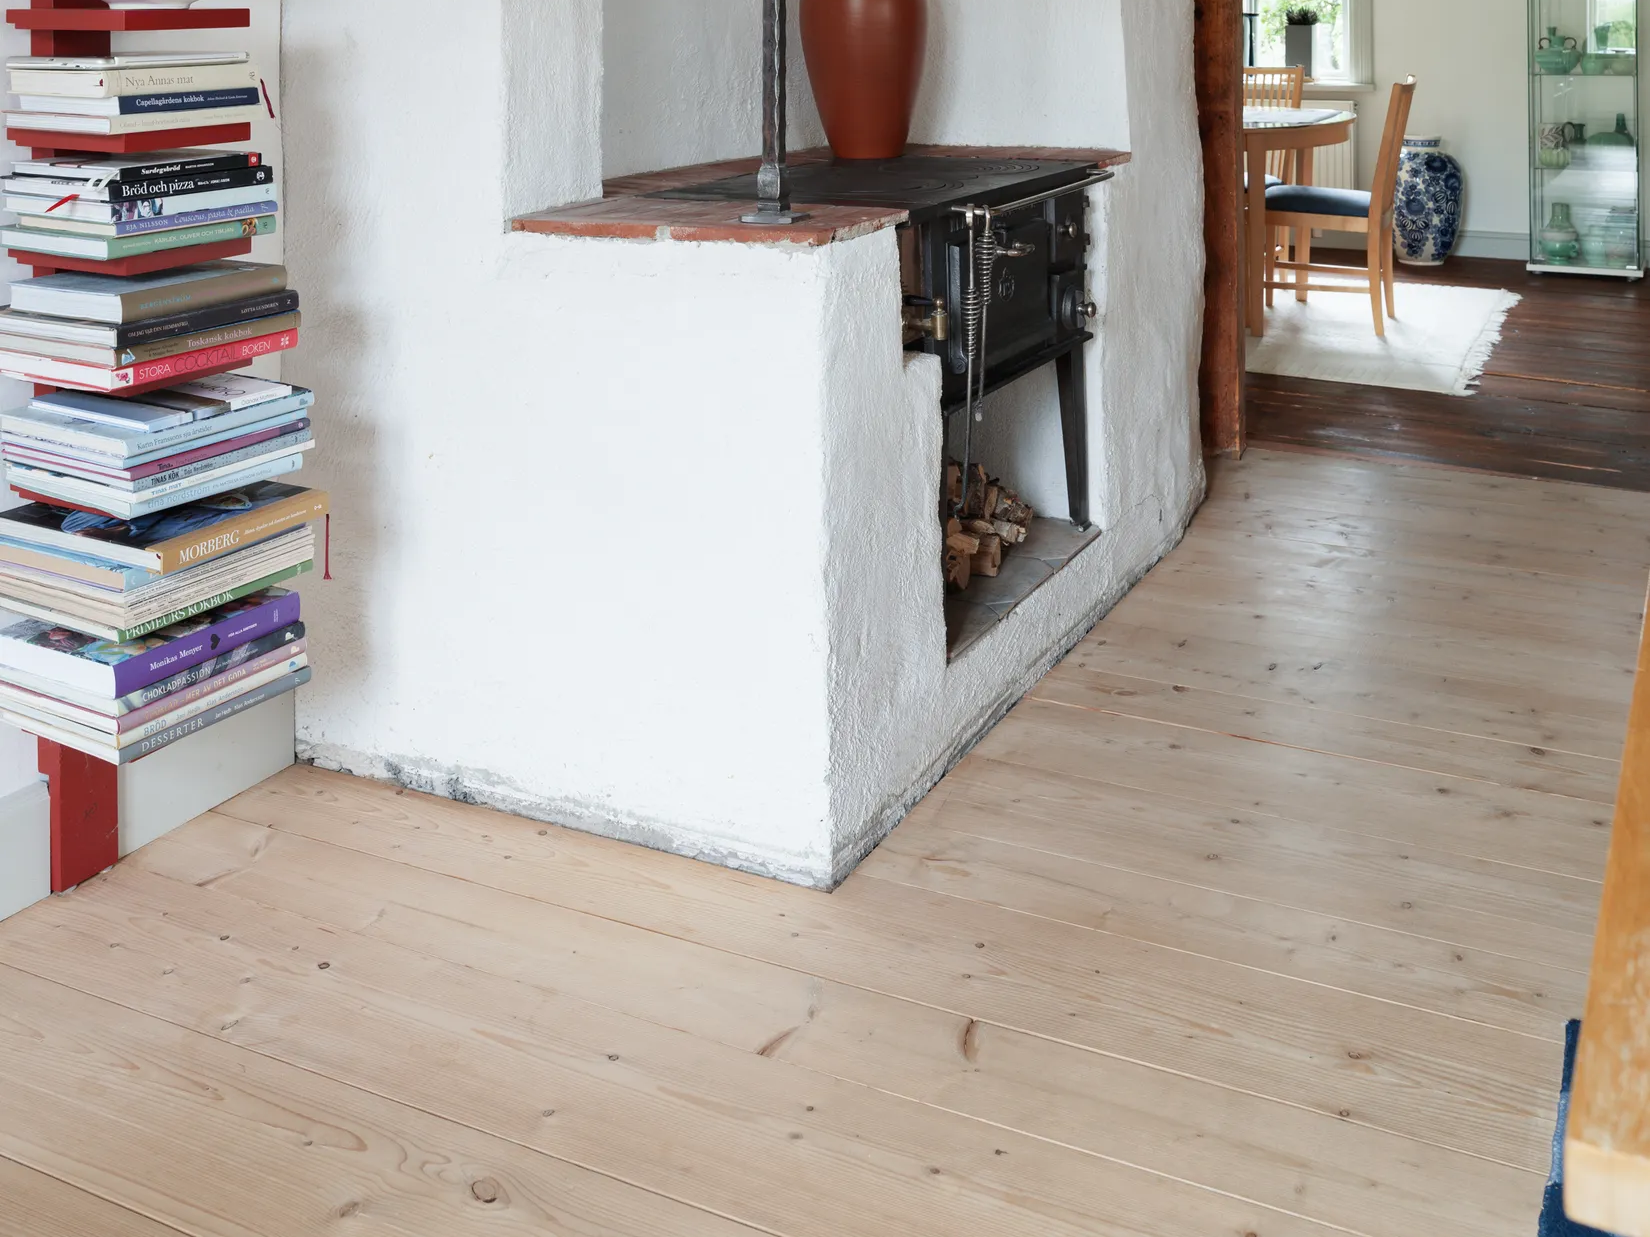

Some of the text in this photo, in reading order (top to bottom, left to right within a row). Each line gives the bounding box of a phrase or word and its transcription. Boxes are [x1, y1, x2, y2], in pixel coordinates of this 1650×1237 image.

[125, 75, 194, 90] Nya Annas mat
[136, 96, 182, 107] Capellagårdens
[184, 95, 204, 103] kokbok
[141, 165, 181, 175] Surdegsbröd
[122, 183, 147, 197] Bröd
[148, 181, 168, 194] och
[168, 179, 195, 195] pizza
[126, 223, 137, 231] EJA
[139, 219, 168, 229] NILSSON
[174, 214, 206, 224] Couscous,
[207, 210, 226, 222] pasta
[234, 206, 255, 217] paella
[241, 306, 255, 314] LOTTA
[186, 333, 222, 348] Toskansk
[224, 327, 253, 340] kokbok
[139, 364, 171, 380] STORA
[174, 346, 241, 373] COCKTAIL
[242, 340, 271, 356] BOKEN
[137, 440, 153, 451] Karin
[154, 432, 182, 447] Franssons
[151, 474, 167, 485] TINAS
[168, 471, 180, 482] KÖK
[148, 497, 166, 508] tina
[167, 485, 211, 504] nordström
[179, 530, 240, 565] MORBERG
[125, 610, 186, 640] PRIMEURS
[188, 591, 234, 619] KOKBOK
[150, 655, 178, 671] Monikas
[179, 645, 203, 659] Menyer
[142, 666, 211, 703] CHOKLADPASSION
[186, 689, 200, 699] MER
[214, 678, 226, 689] DET
[228, 669, 247, 682] GODA
[141, 718, 204, 752] DESSERTER
[143, 720, 167, 735] BRÖD
